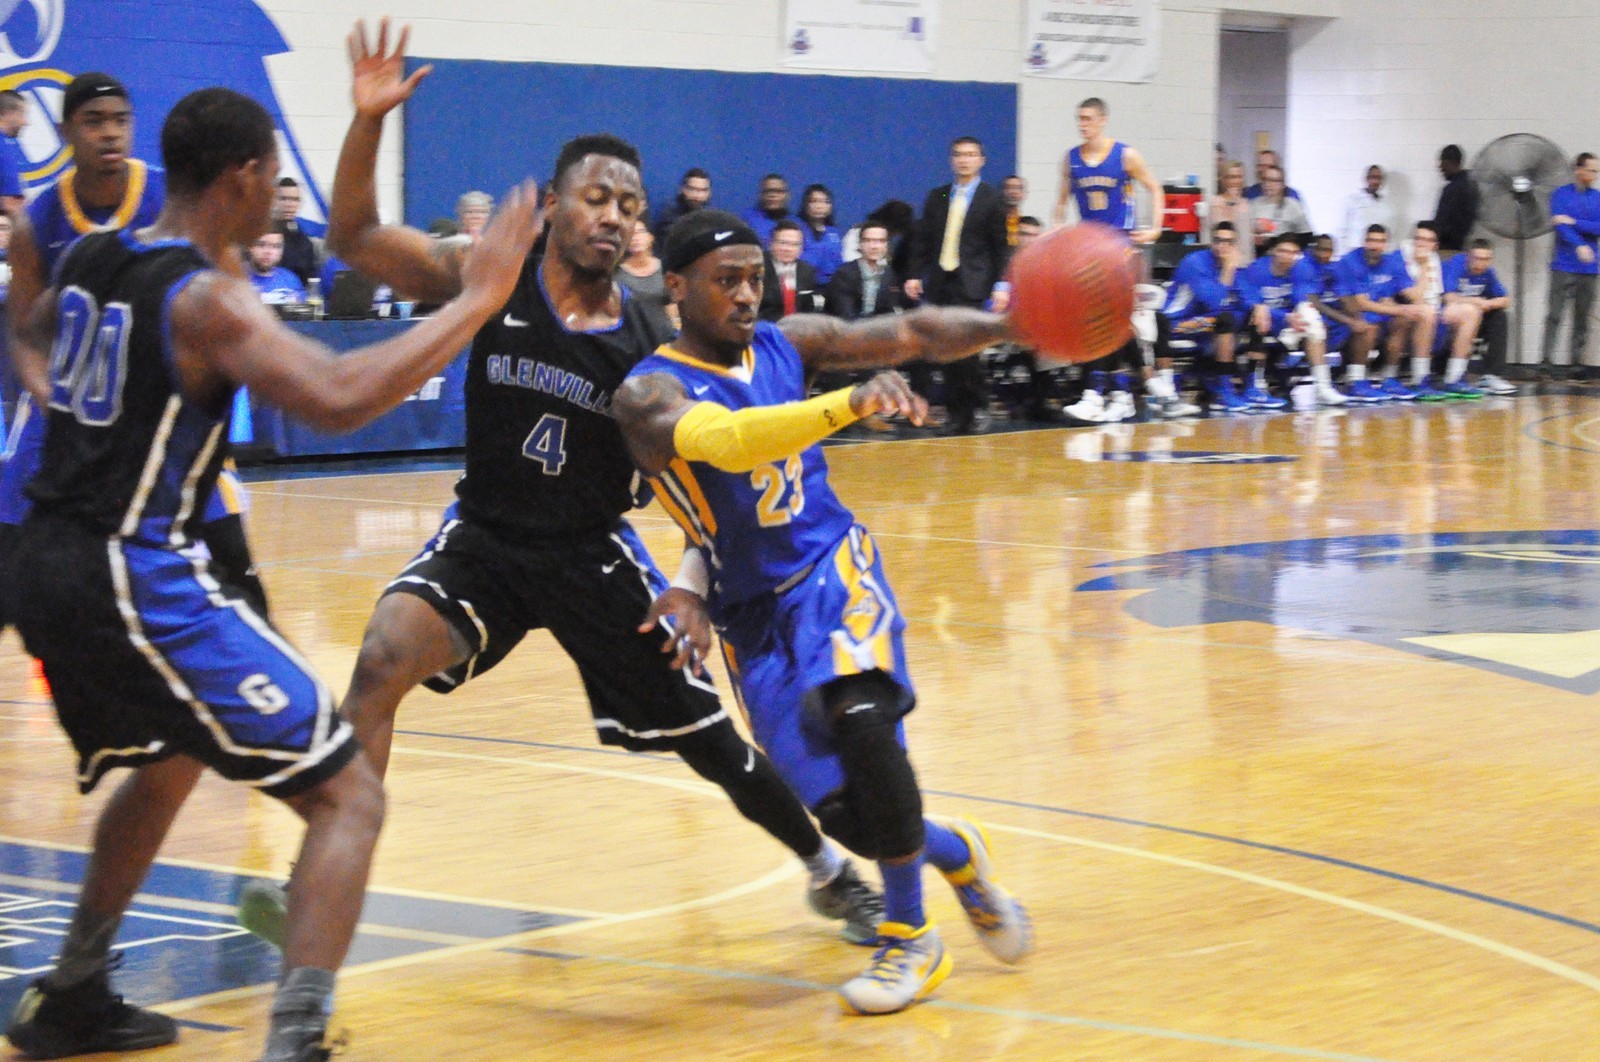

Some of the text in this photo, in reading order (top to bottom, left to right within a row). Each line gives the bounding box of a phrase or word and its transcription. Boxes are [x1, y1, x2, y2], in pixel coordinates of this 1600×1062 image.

[487, 354, 612, 417] GLENVILL
[522, 413, 567, 476] 4
[750, 454, 805, 528] 23
[236, 672, 290, 715] G
